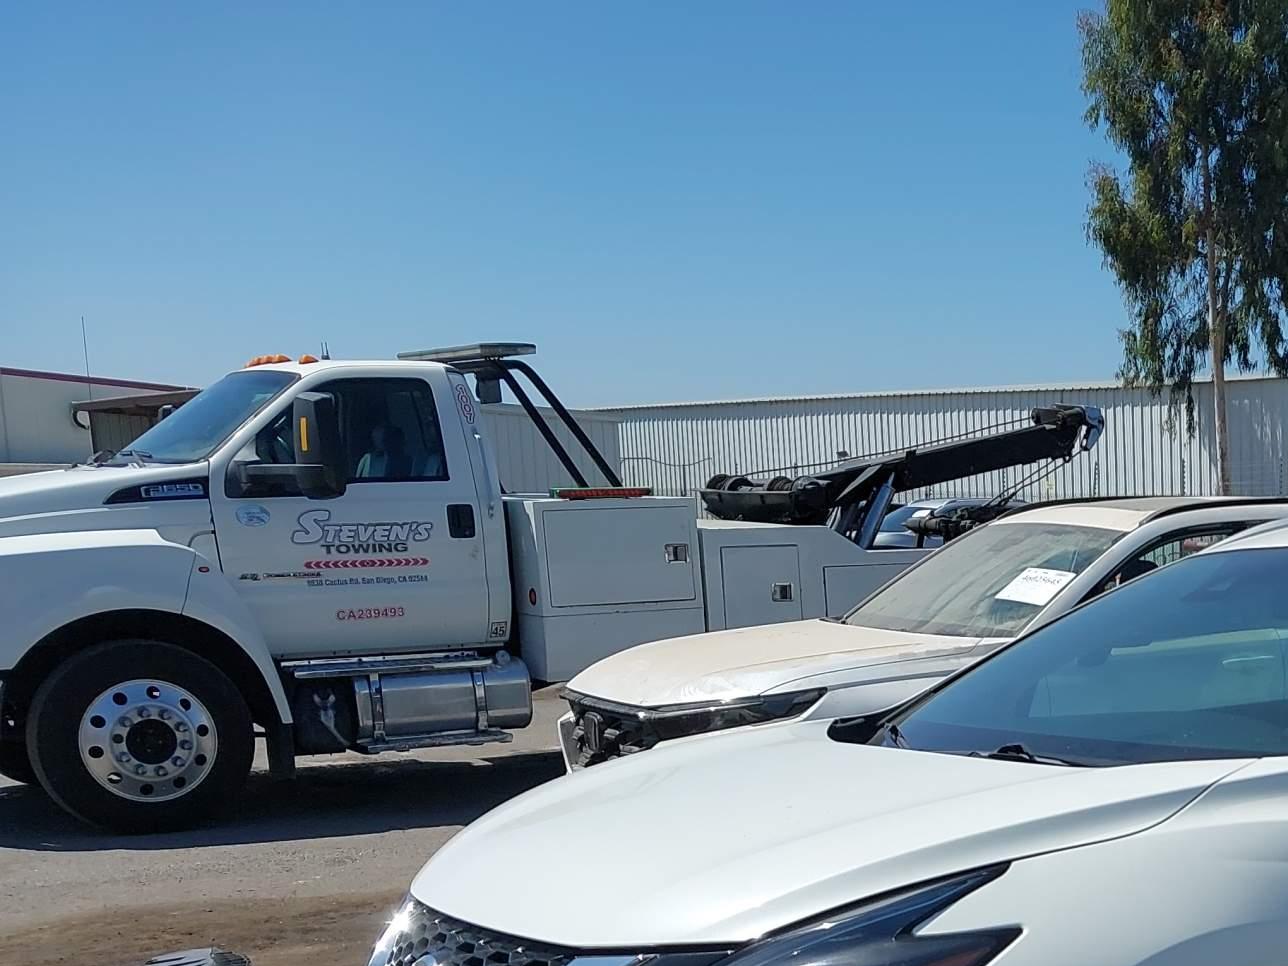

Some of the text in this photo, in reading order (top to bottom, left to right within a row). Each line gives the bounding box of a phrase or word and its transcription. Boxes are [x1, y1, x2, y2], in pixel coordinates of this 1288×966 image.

[320, 542, 409, 555] TOWING
[398, 575, 407, 583] CA
[336, 606, 405, 621] CA239493
[492, 625, 506, 637] 45
